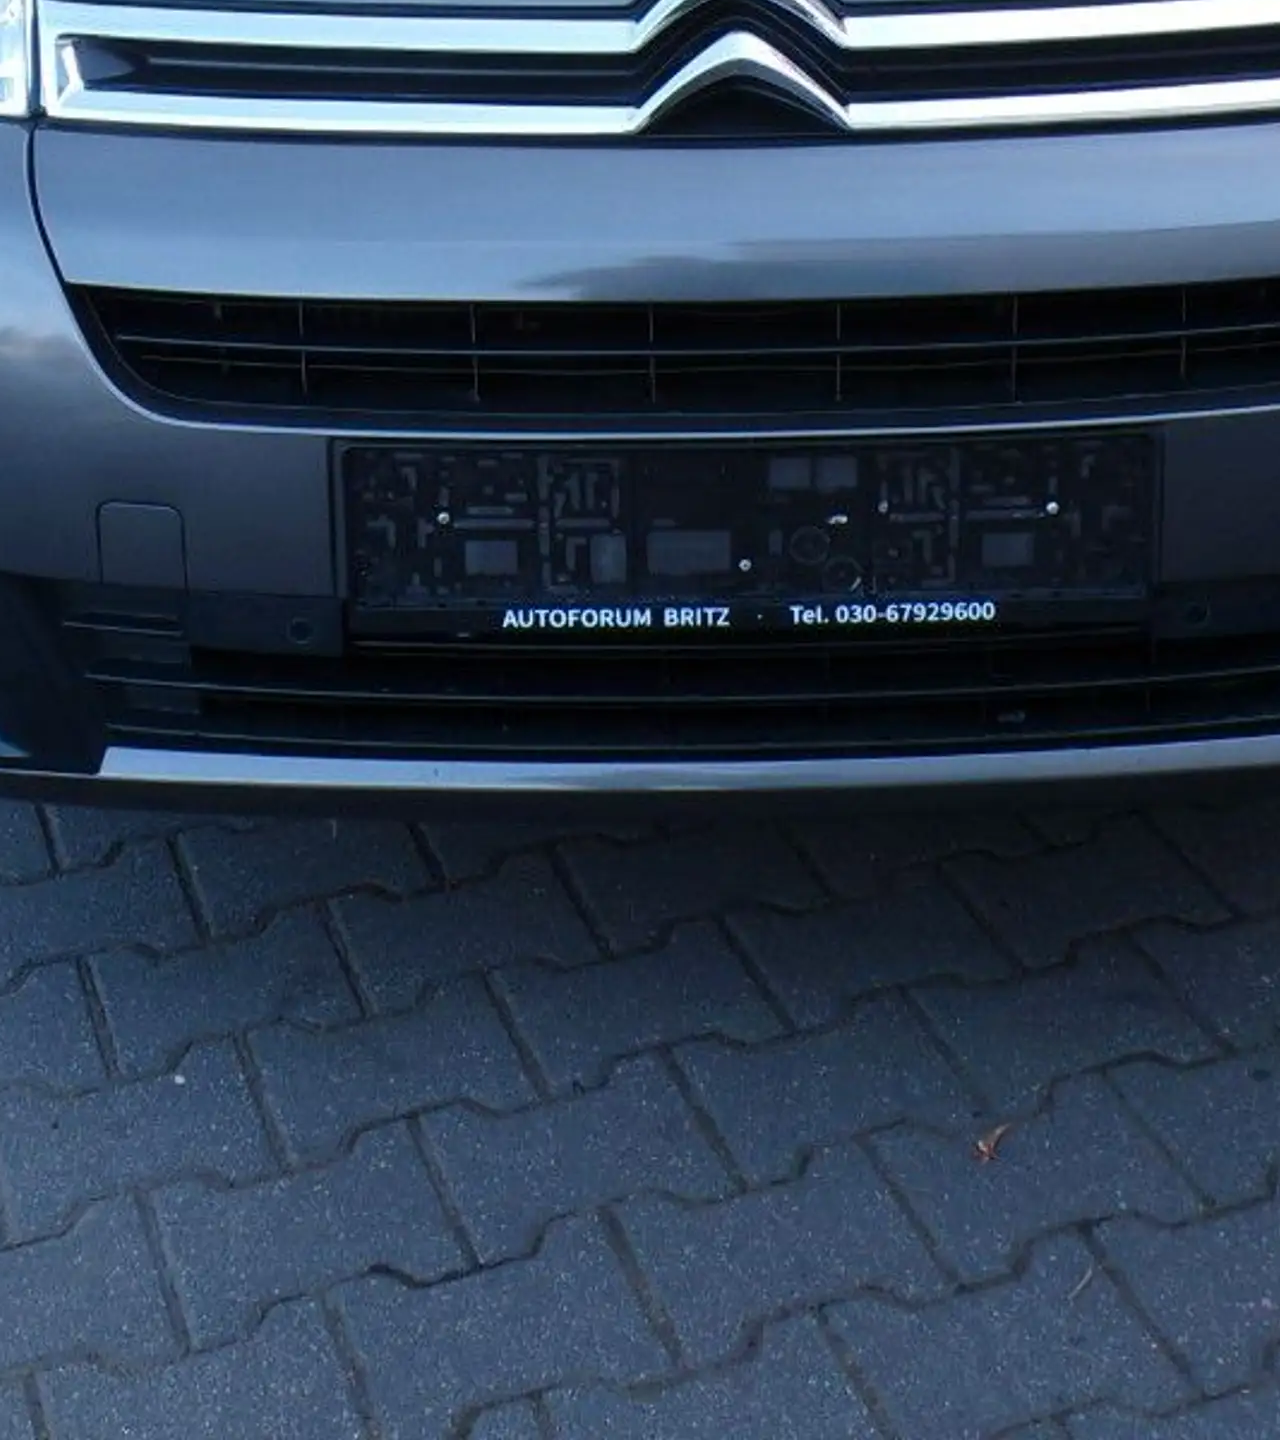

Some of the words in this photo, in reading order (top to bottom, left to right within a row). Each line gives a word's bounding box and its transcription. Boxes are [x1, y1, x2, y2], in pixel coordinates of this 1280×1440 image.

[502, 607, 652, 628] AUTOFORUM
[663, 606, 731, 627] BRITZ
[789, 604, 830, 625] Tel.
[834, 601, 997, 624] 030-67929600
